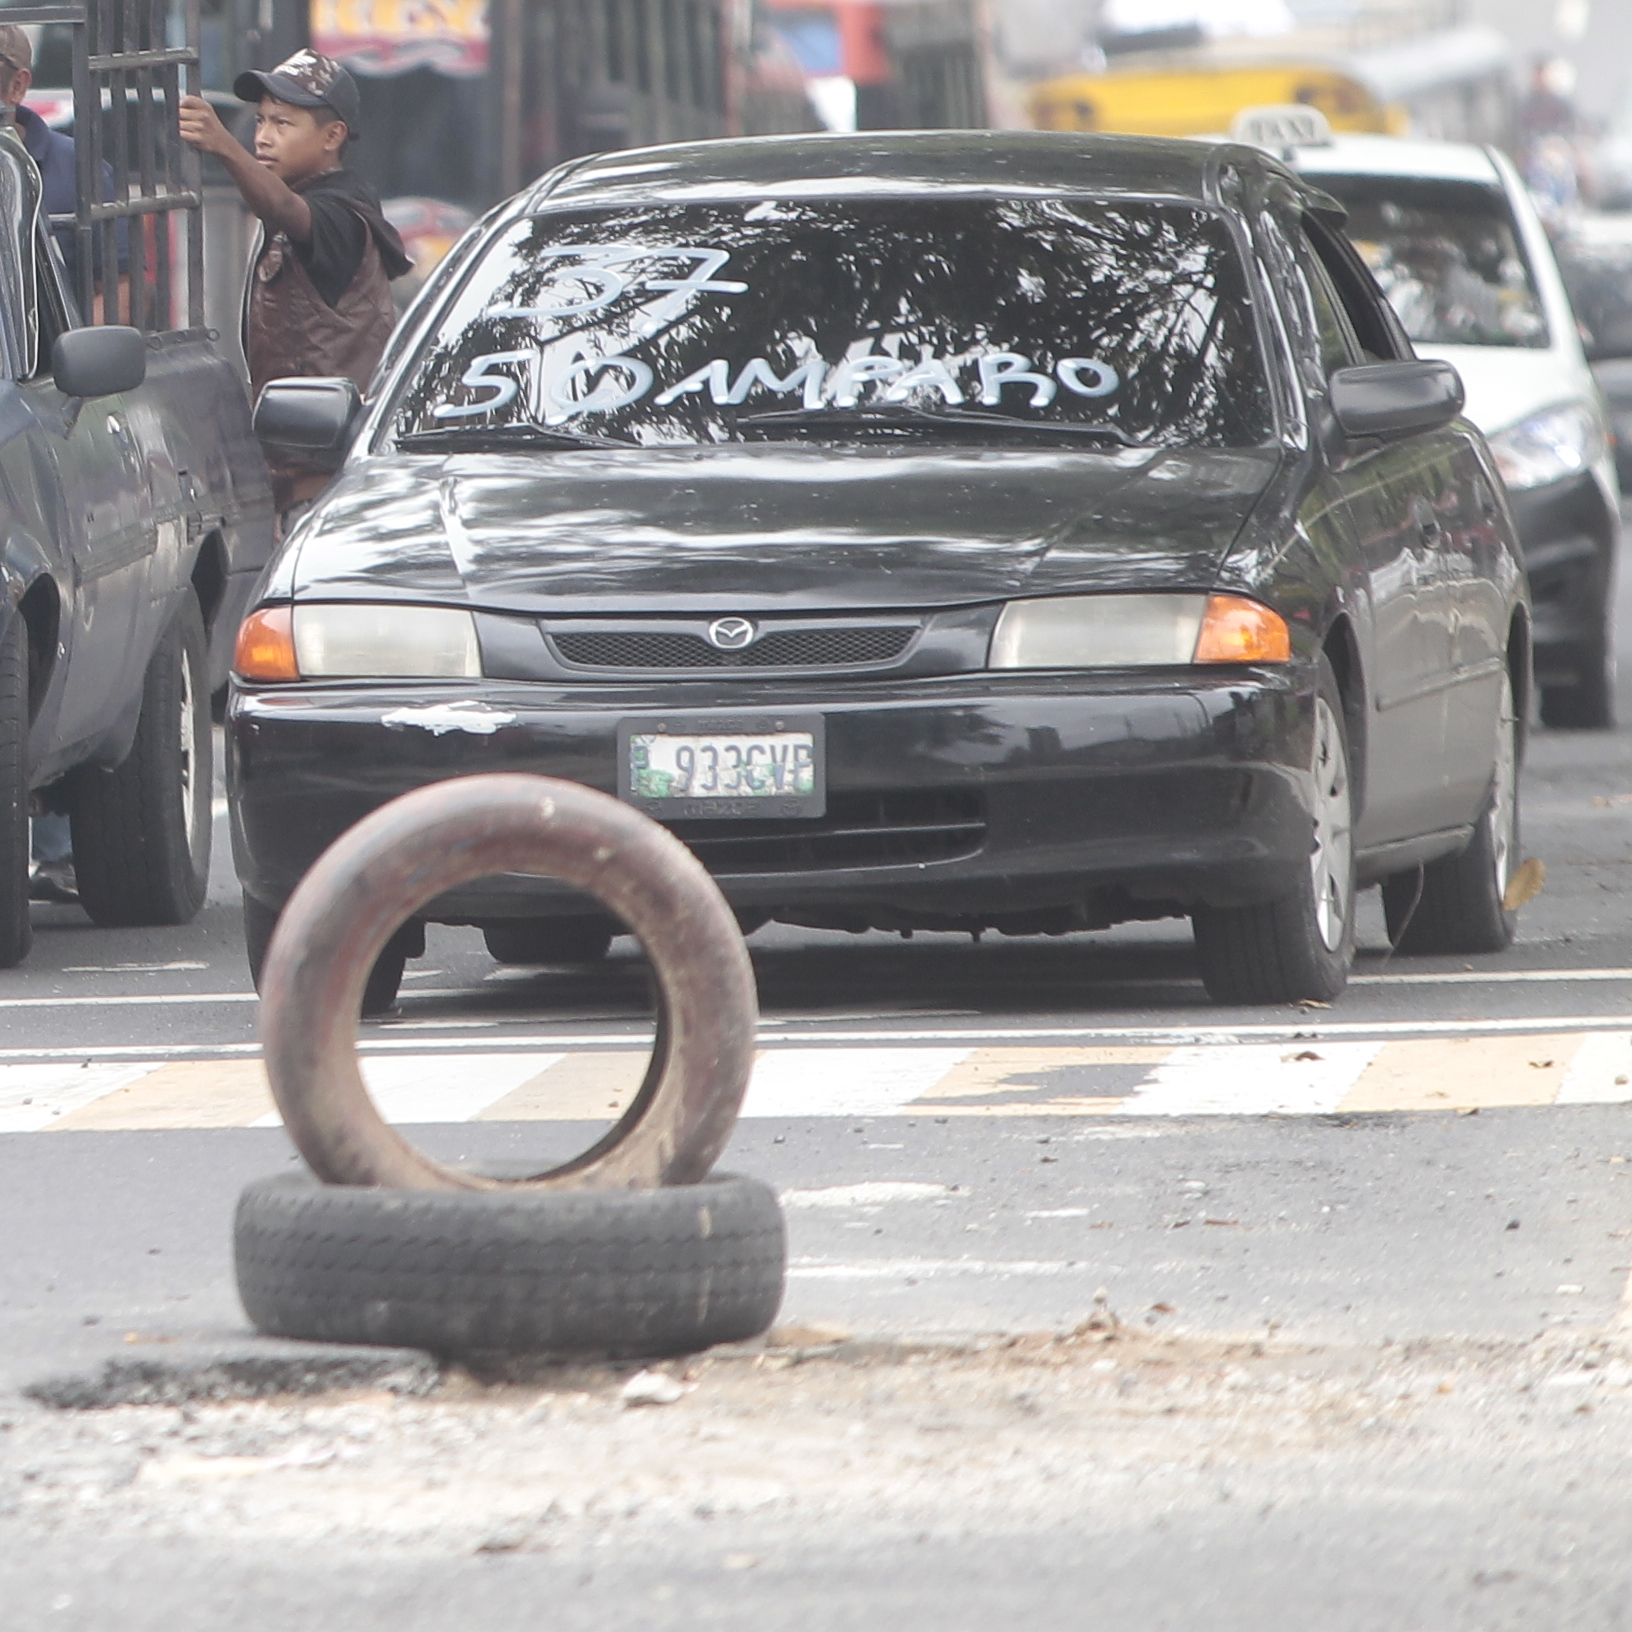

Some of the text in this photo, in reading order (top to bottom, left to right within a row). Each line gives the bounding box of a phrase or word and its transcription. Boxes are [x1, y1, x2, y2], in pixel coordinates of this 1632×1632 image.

[1248, 114, 1315, 141] TAXI
[486, 244, 749, 339] 37
[654, 351, 1120, 410] AMPARO
